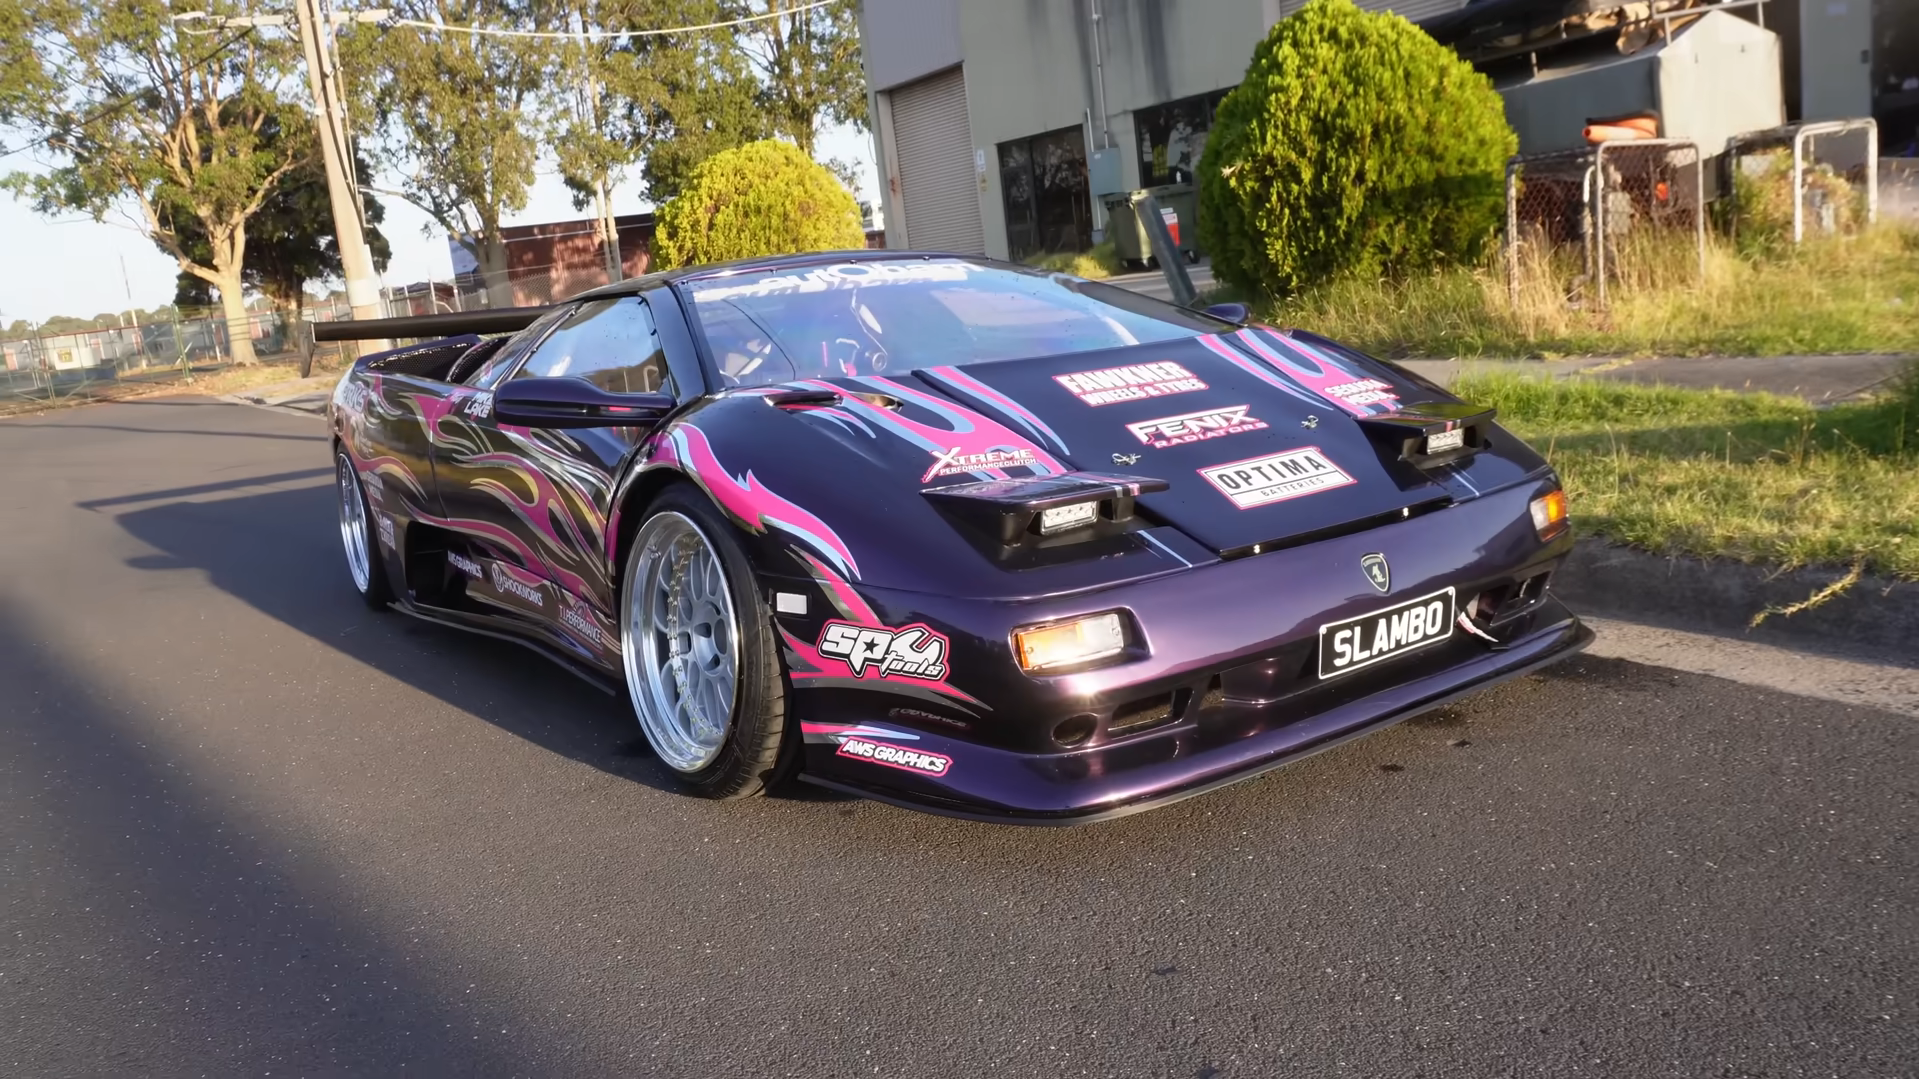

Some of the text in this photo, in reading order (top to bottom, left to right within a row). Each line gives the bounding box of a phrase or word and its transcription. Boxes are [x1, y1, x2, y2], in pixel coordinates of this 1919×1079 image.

[1055, 361, 1193, 394] FAWKNER
[464, 402, 491, 418] LAKE
[1080, 386, 1147, 405] WHEELS
[1126, 405, 1260, 445] FENIX
[1154, 421, 1269, 449] RADIATORS
[923, 446, 1036, 483] XTREME
[1217, 455, 1327, 490] OPTIMA
[1261, 477, 1325, 497] BATTERIES
[1333, 600, 1443, 667] SLAMBO
[880, 650, 944, 677] tools
[842, 739, 947, 773] AWS GRAPHICS
